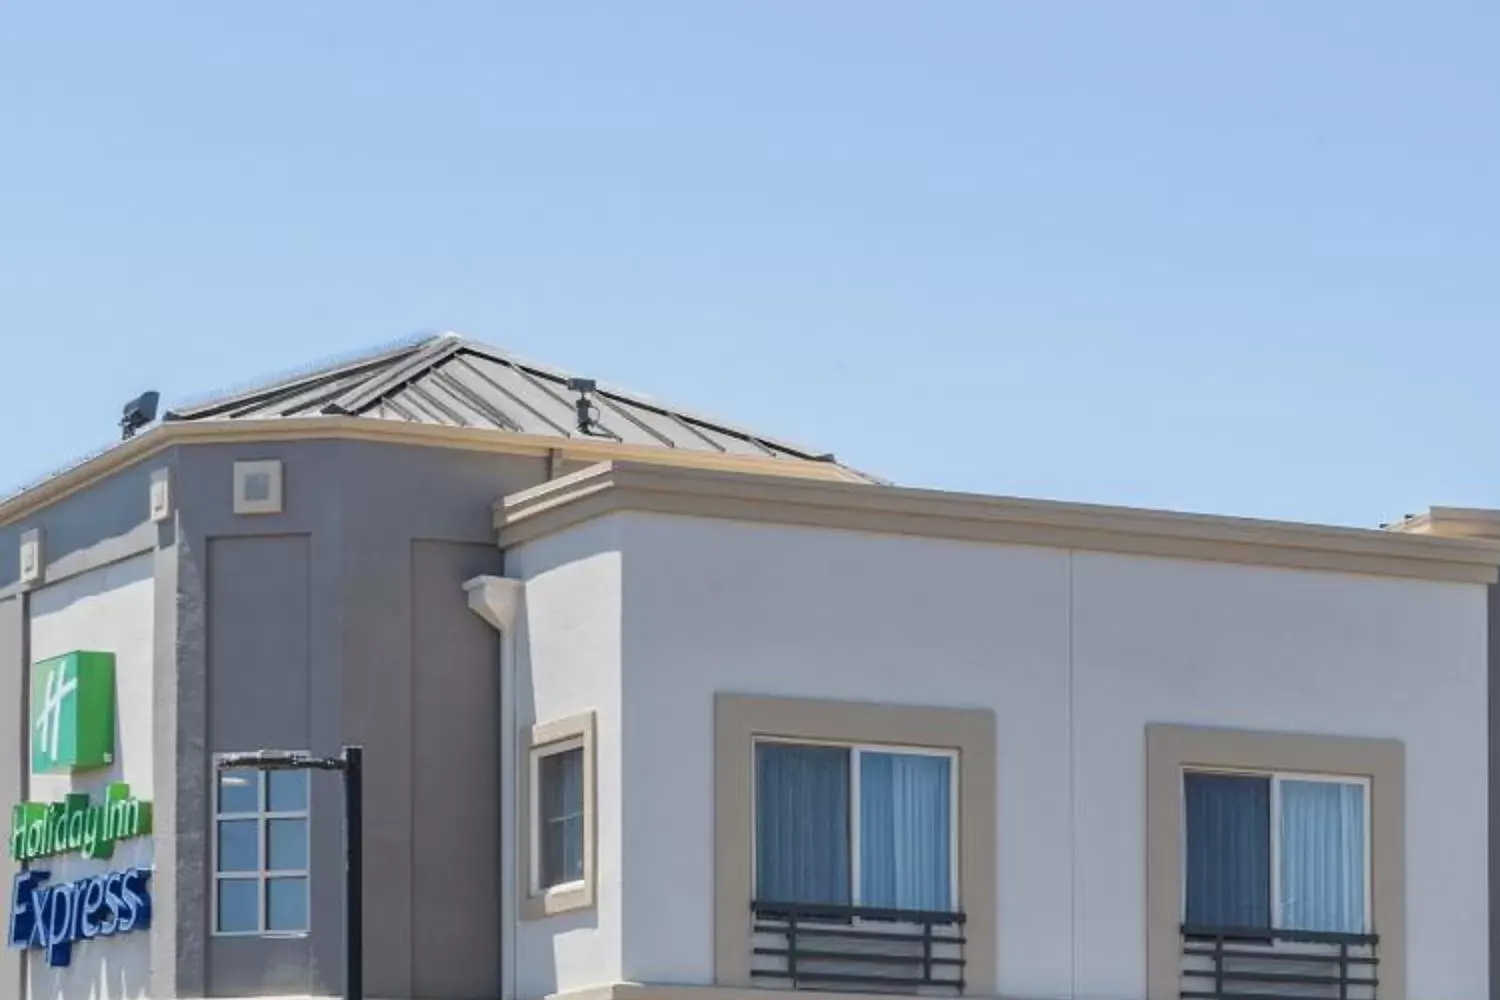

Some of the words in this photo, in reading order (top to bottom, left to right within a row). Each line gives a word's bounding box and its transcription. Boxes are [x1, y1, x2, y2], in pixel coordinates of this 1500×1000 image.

[10, 796, 101, 861] Holiday
[102, 783, 141, 842] Inn
[8, 867, 144, 969] Express
